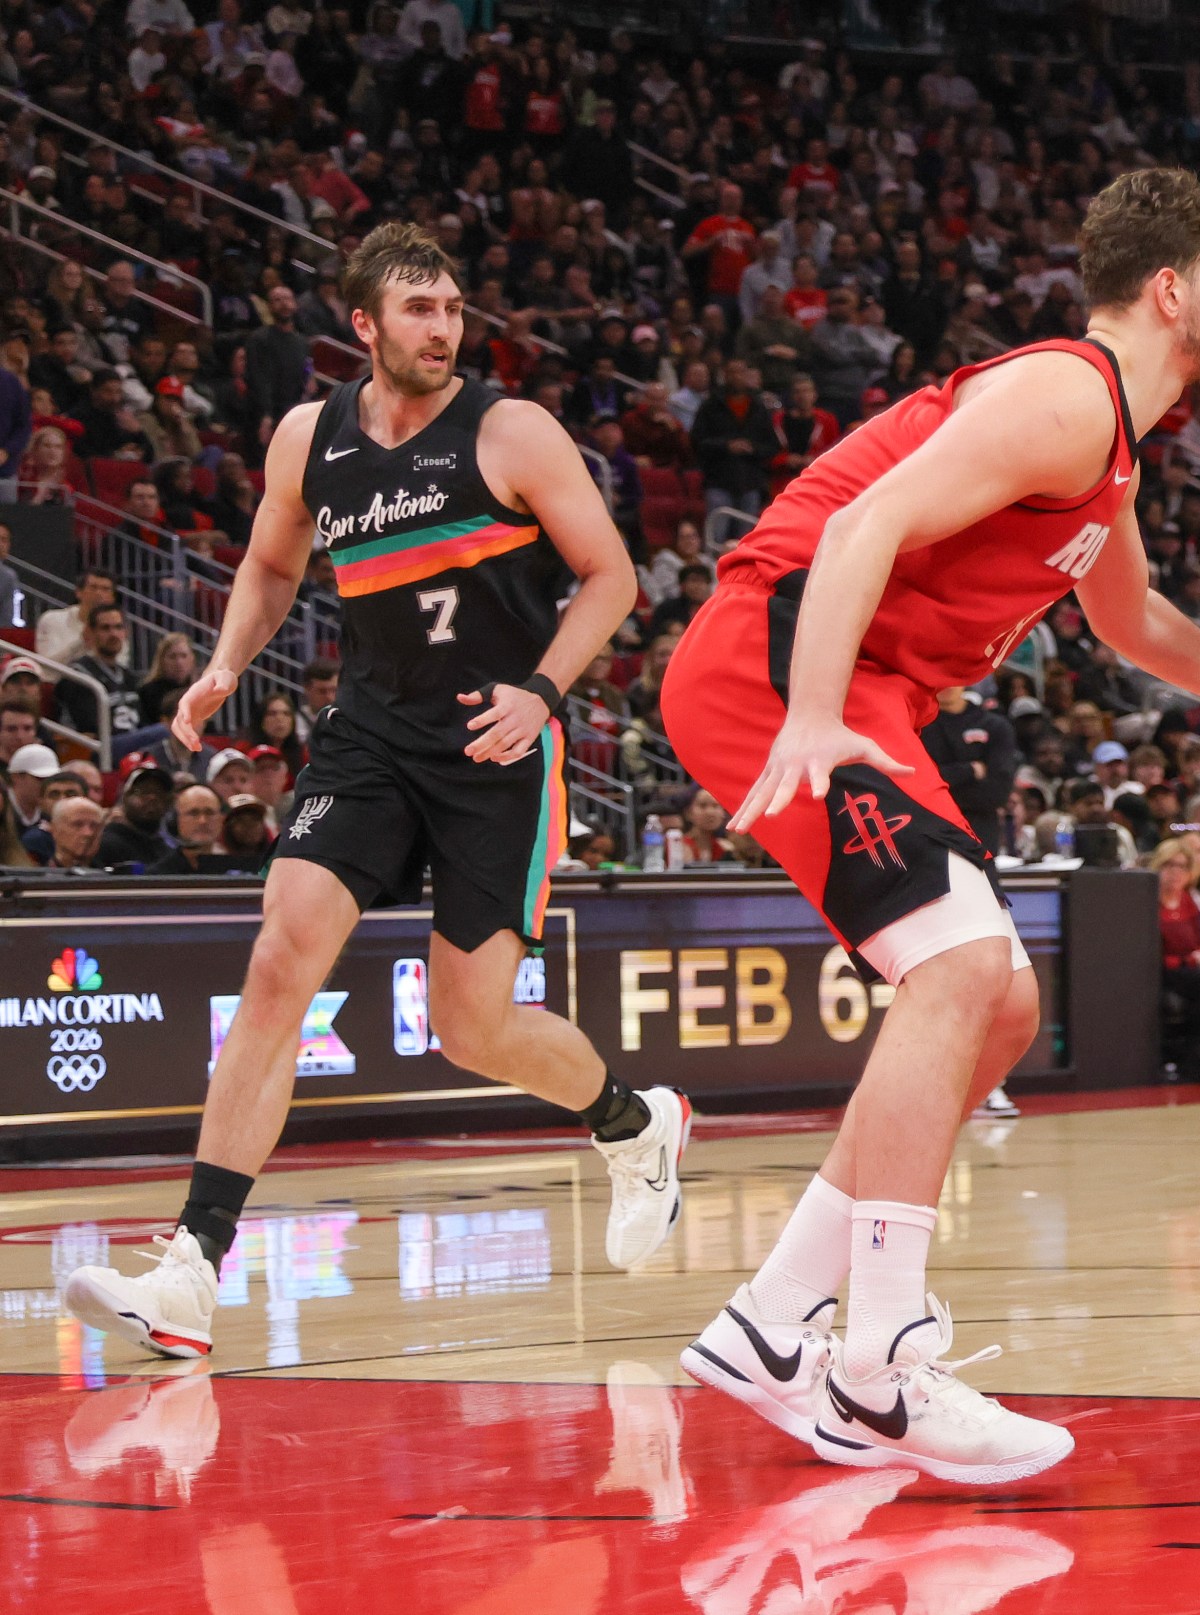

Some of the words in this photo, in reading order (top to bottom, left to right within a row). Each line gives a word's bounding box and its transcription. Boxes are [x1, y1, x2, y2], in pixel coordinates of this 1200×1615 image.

[418, 458, 451, 467] LEDGER
[317, 506, 355, 548] San
[358, 484, 449, 533] Antonio
[416, 586, 460, 645] 7
[57, 993, 164, 1025] CORTINA
[620, 947, 792, 1051] FEB
[50, 1028, 103, 1052] 2026
